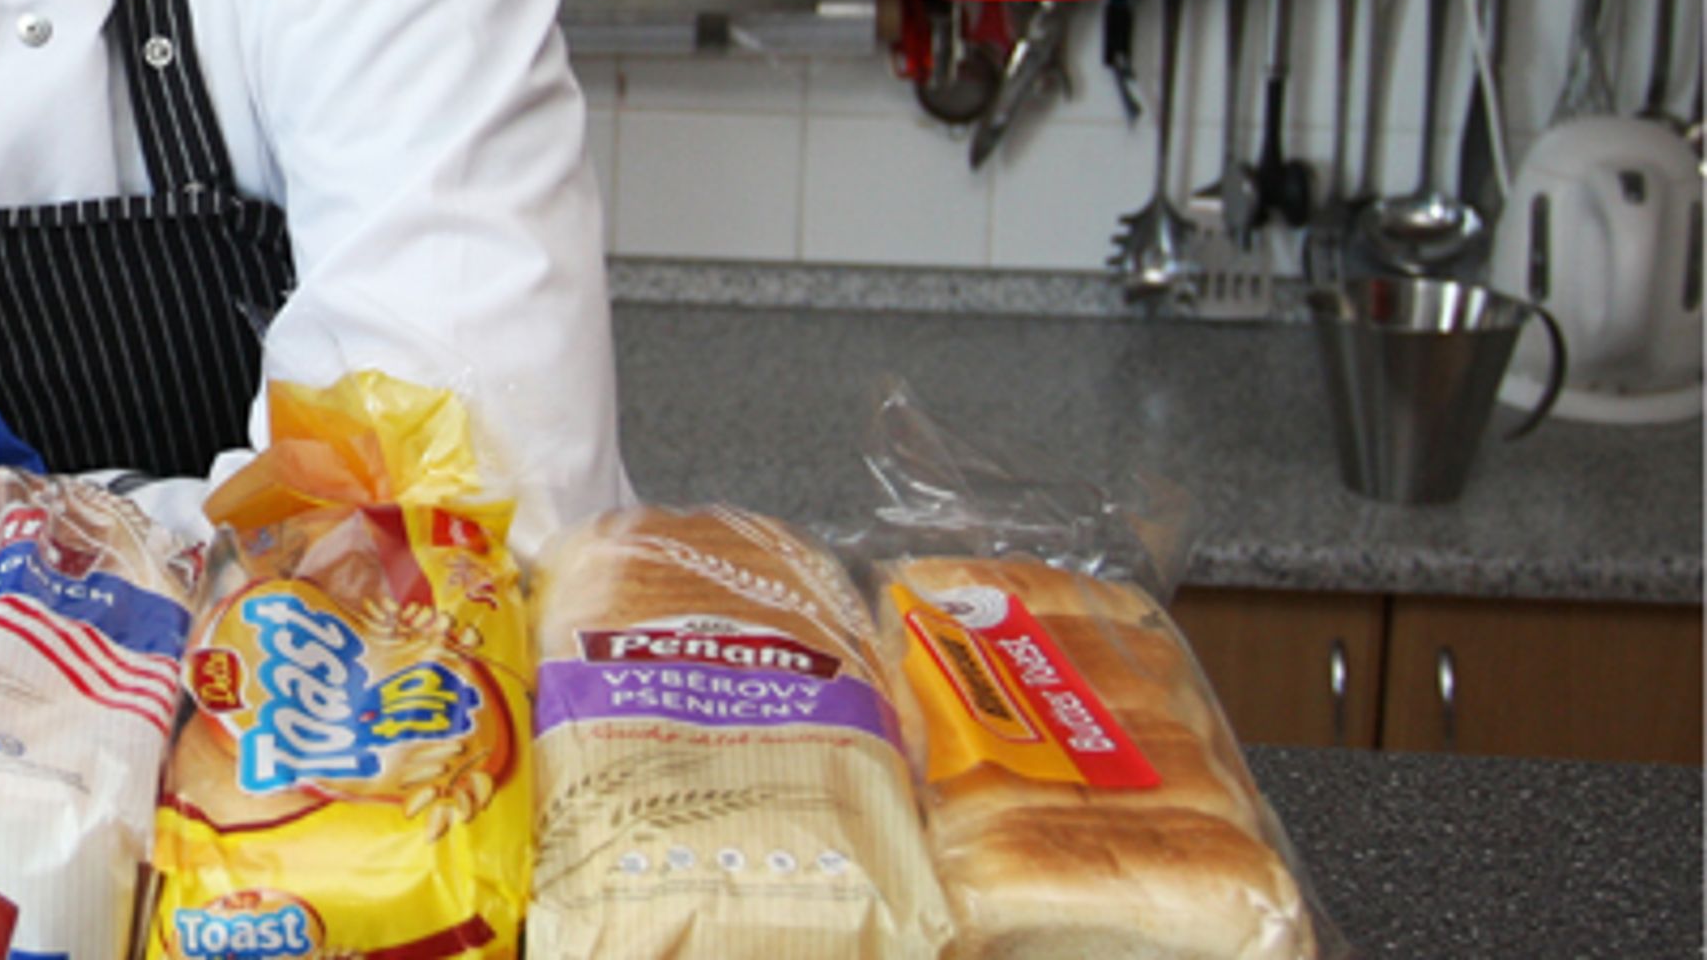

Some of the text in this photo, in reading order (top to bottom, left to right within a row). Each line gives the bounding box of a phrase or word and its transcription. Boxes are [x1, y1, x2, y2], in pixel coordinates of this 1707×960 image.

[608, 634, 813, 671] Penam
[254, 596, 460, 782] Toast tip
[179, 912, 305, 953] Toast
